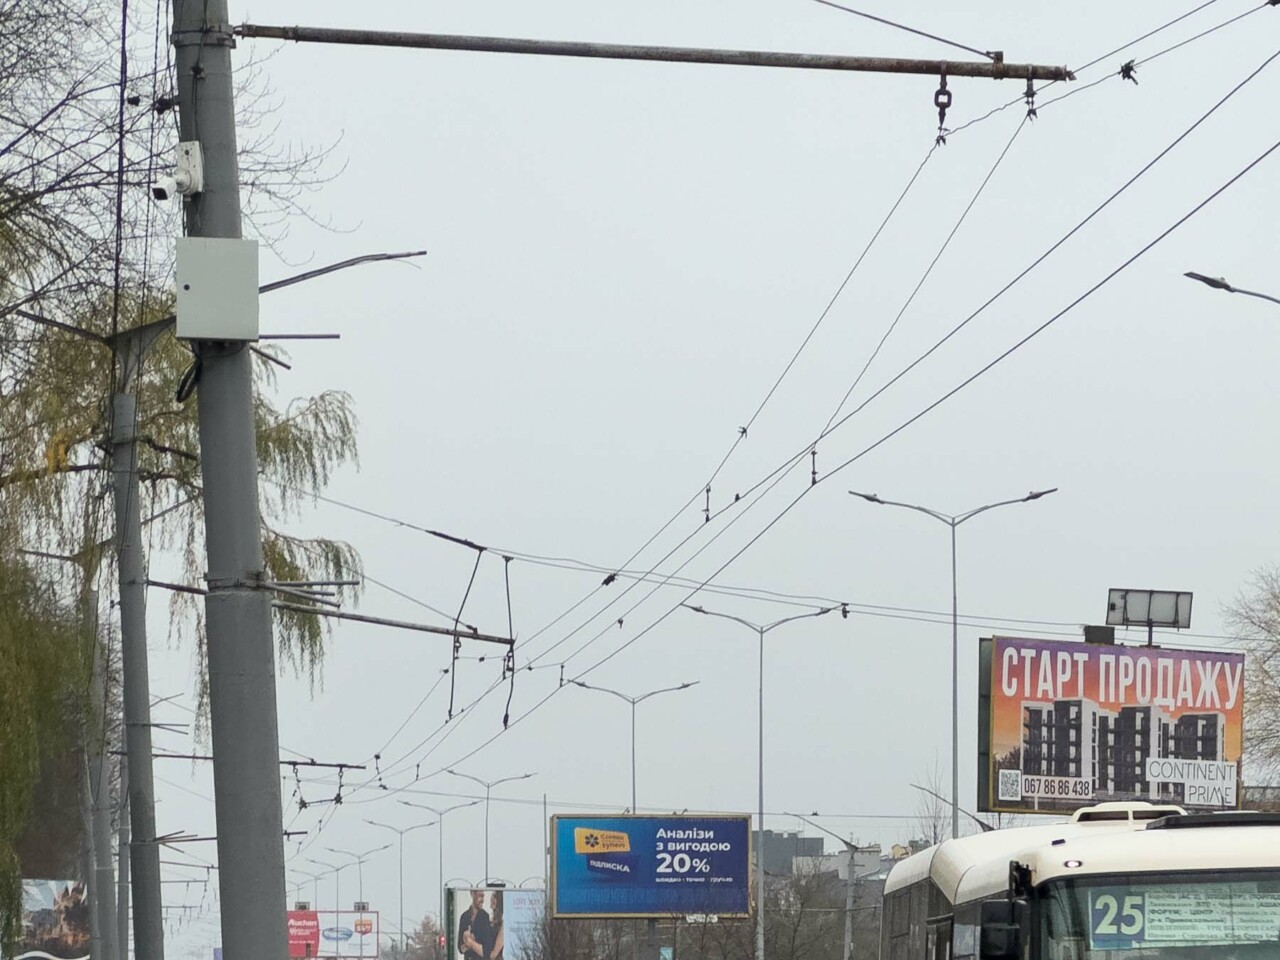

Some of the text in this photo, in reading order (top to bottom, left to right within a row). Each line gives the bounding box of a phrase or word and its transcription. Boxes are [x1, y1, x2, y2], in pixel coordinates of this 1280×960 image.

[1002, 646, 1243, 711] СТАРТ ПРОДАЖУ
[1149, 760, 1235, 781] CONTINENT
[1024, 778, 1090, 796] 067 86 86 438
[1188, 785, 1232, 804] PRIME
[656, 827, 714, 839] Аналізи
[656, 842, 731, 852] з вигодою
[656, 852, 711, 873] 20%
[288, 919, 317, 927] Auchan
[1095, 894, 1144, 935] 25
